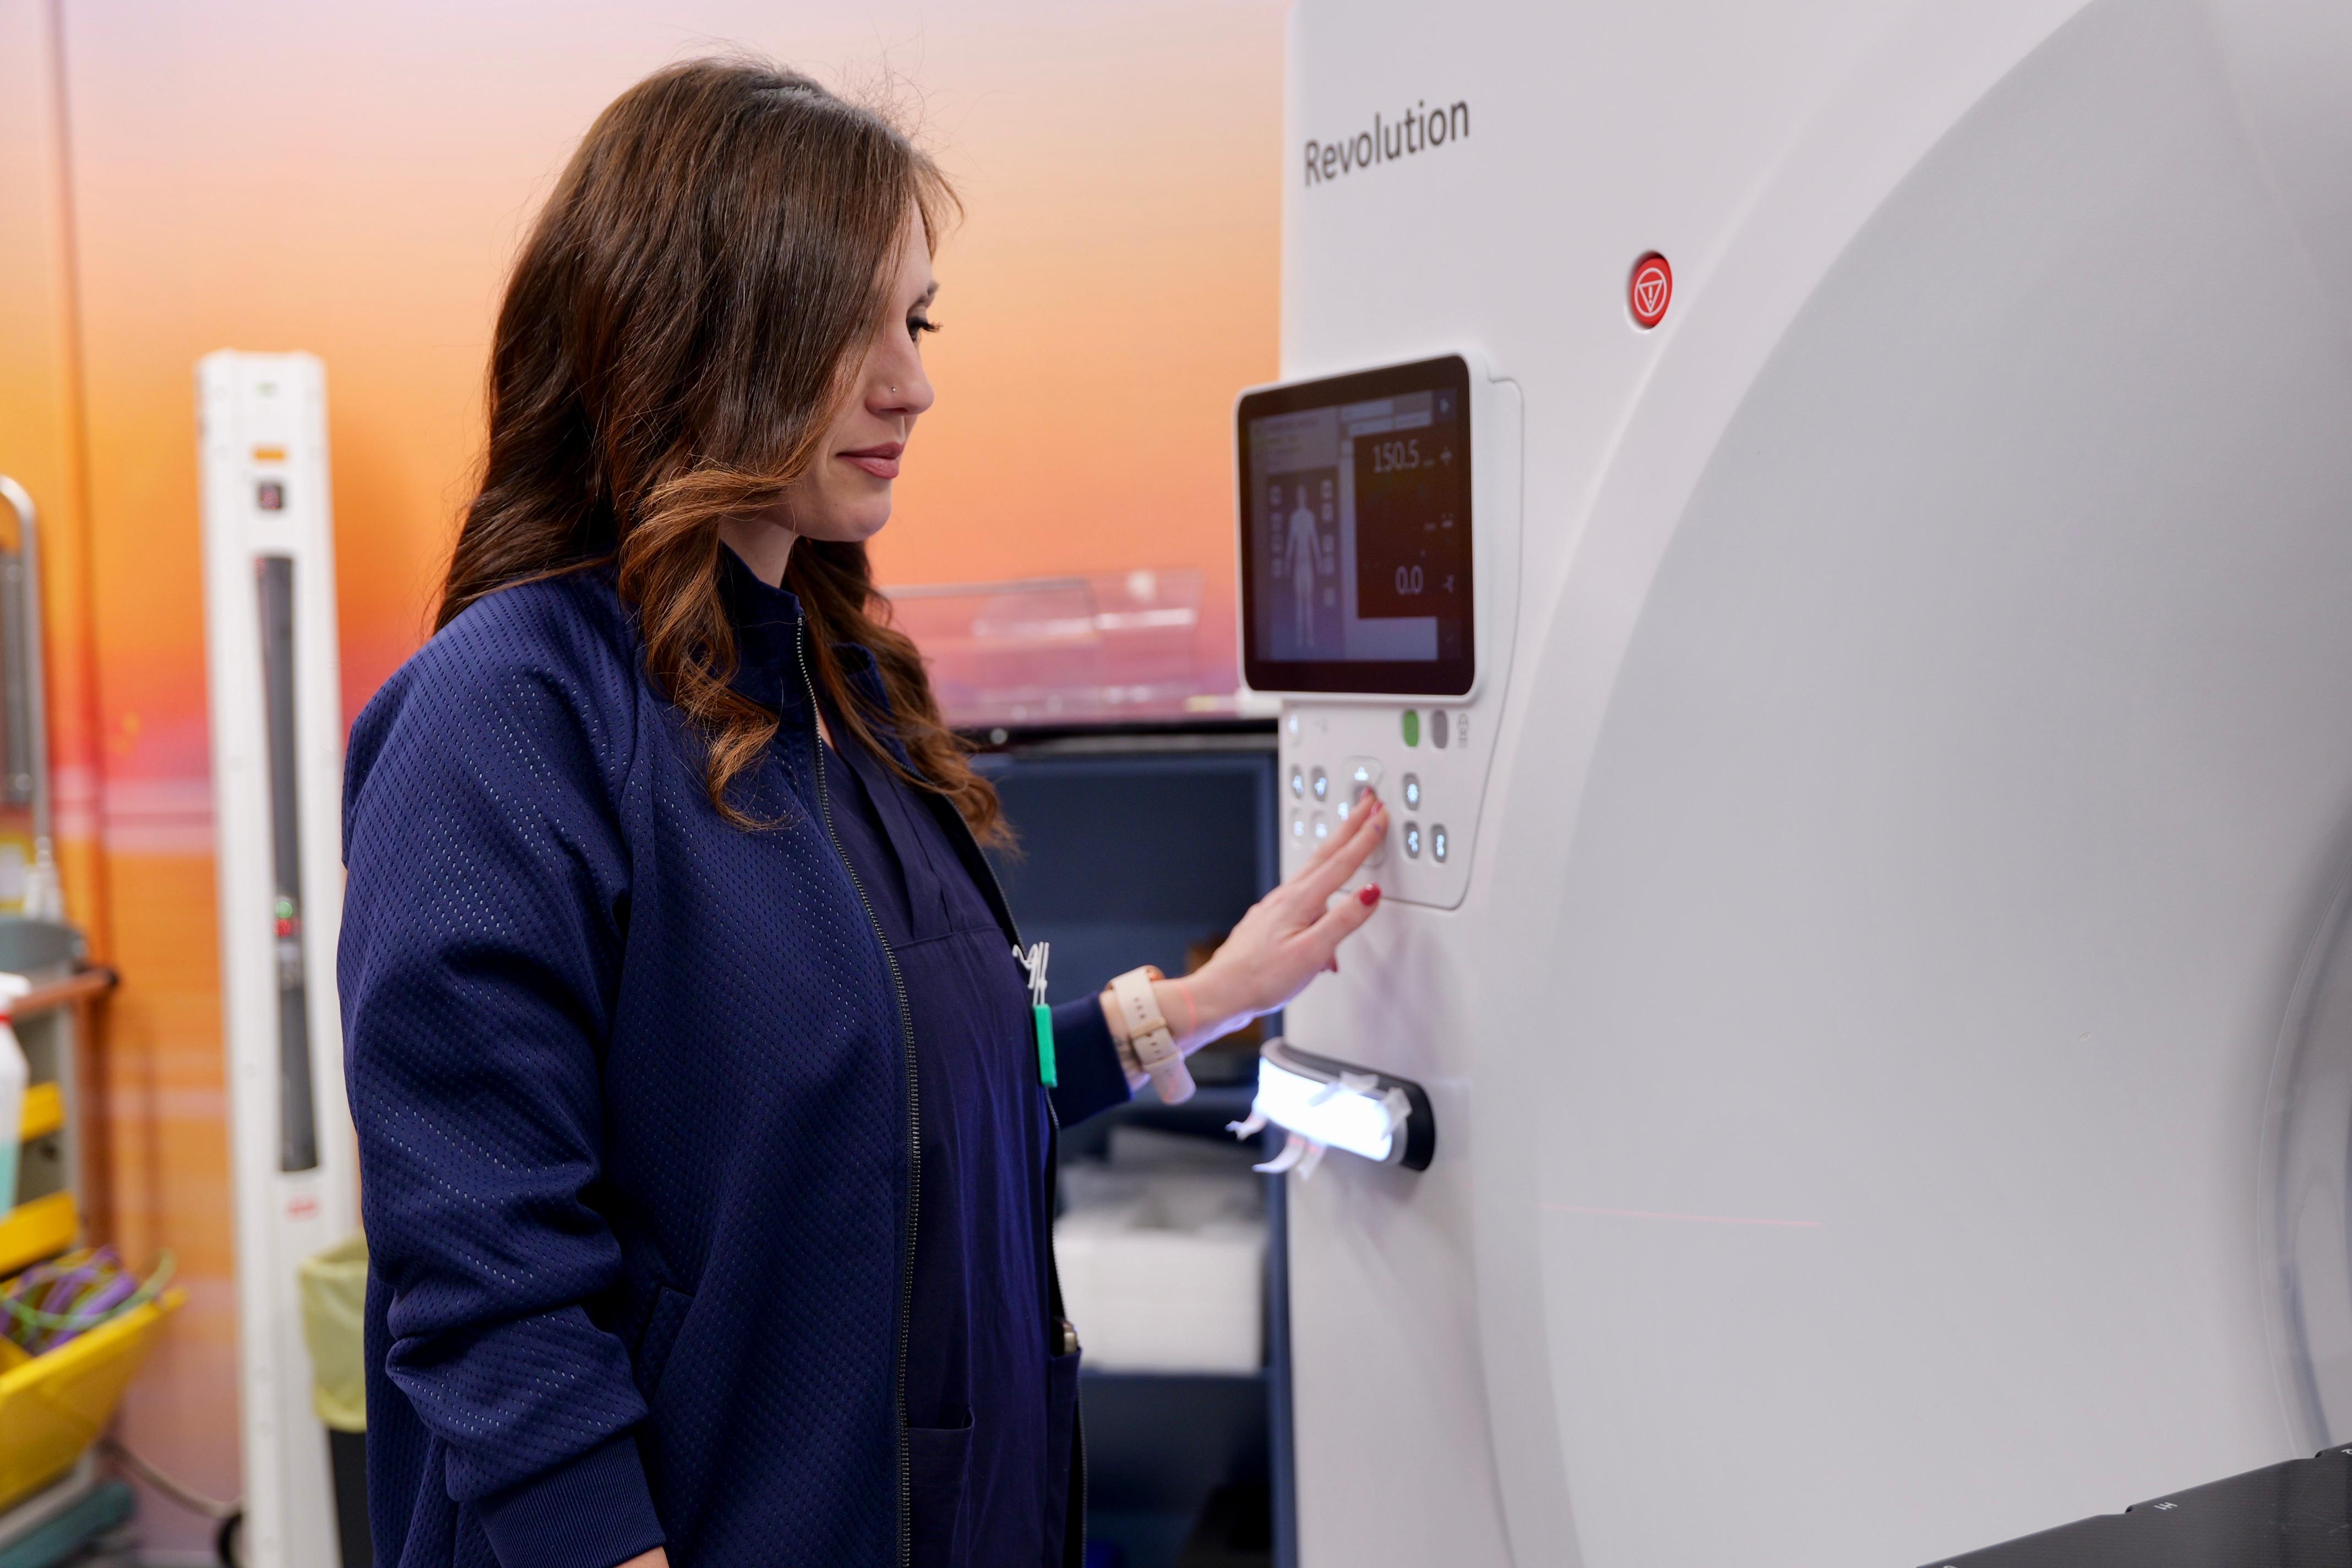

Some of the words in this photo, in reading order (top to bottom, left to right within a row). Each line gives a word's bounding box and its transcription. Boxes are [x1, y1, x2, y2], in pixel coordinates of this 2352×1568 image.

[1305, 99, 1469, 186] Revolution
[1374, 439, 1419, 474] 150.5
[1395, 565, 1424, 595] 0.0
